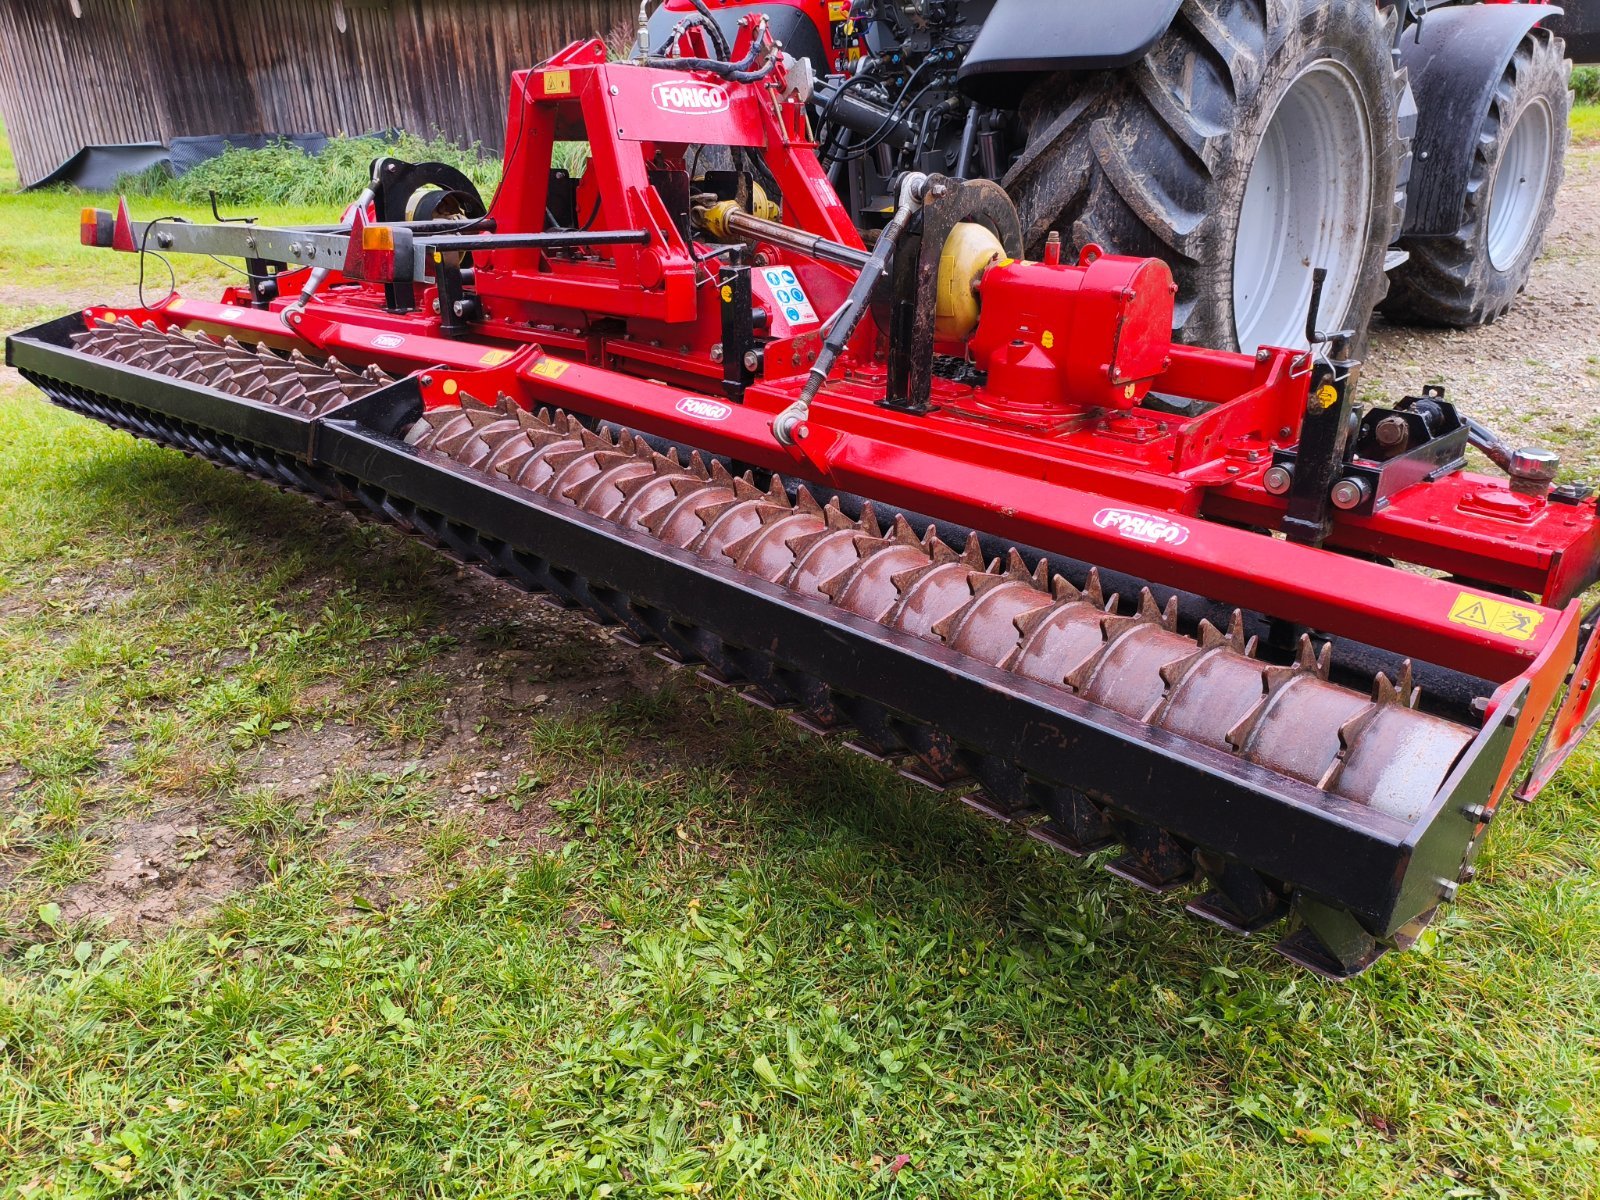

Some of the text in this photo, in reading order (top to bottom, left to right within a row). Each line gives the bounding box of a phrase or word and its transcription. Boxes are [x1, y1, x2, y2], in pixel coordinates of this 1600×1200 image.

[659, 87, 722, 108] FORIGO
[681, 399, 727, 418] FORIGO
[1101, 511, 1179, 542] FORIGO
